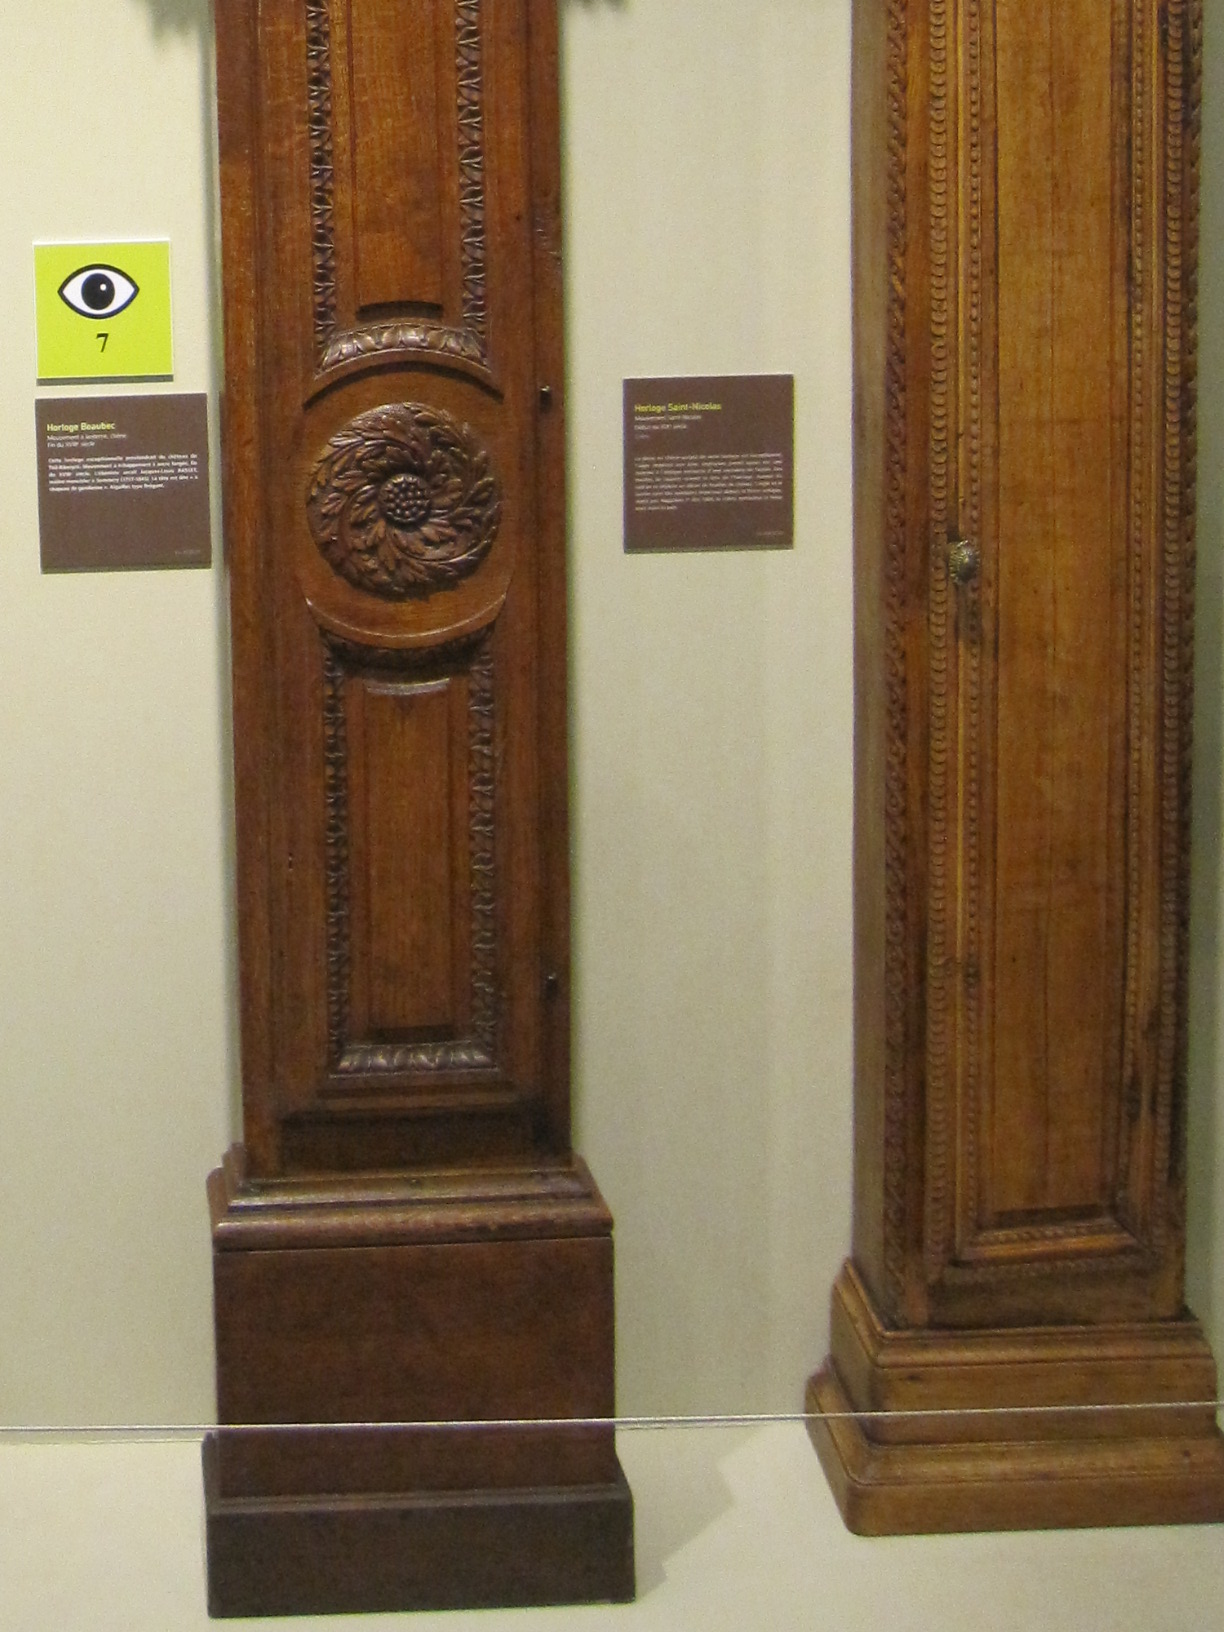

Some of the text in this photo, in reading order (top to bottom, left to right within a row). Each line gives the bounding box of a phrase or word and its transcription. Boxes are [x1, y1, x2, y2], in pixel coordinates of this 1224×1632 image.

[96, 333, 109, 353] 7
[46, 421, 116, 433] Horloge Beaubec
